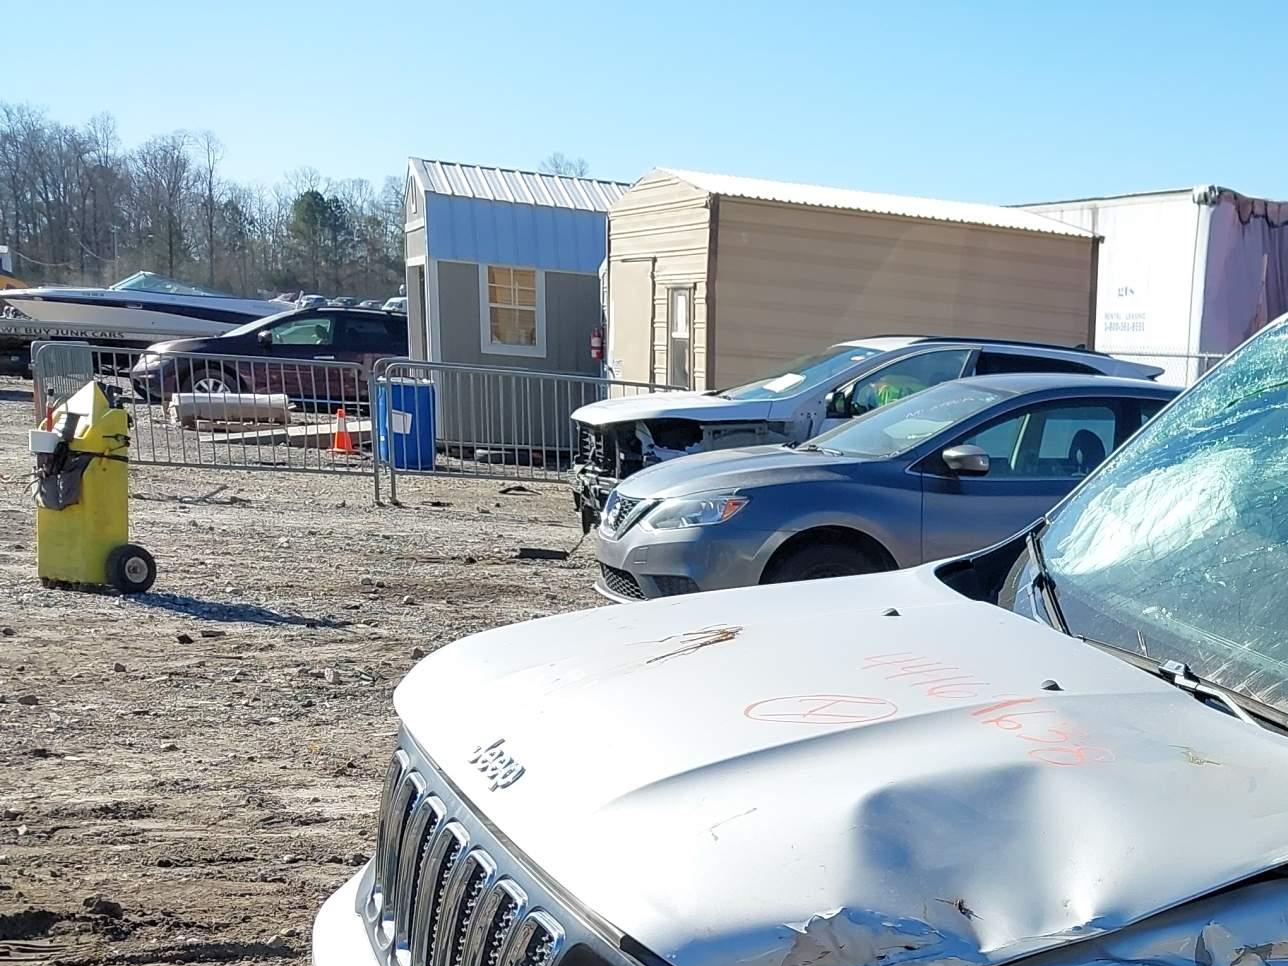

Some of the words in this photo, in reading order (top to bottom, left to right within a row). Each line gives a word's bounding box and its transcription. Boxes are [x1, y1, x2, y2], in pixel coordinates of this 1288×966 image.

[25, 327, 50, 336] BUY
[55, 328, 88, 338] JUNK
[91, 330, 125, 339] CARS
[467, 738, 526, 792] Jeep
